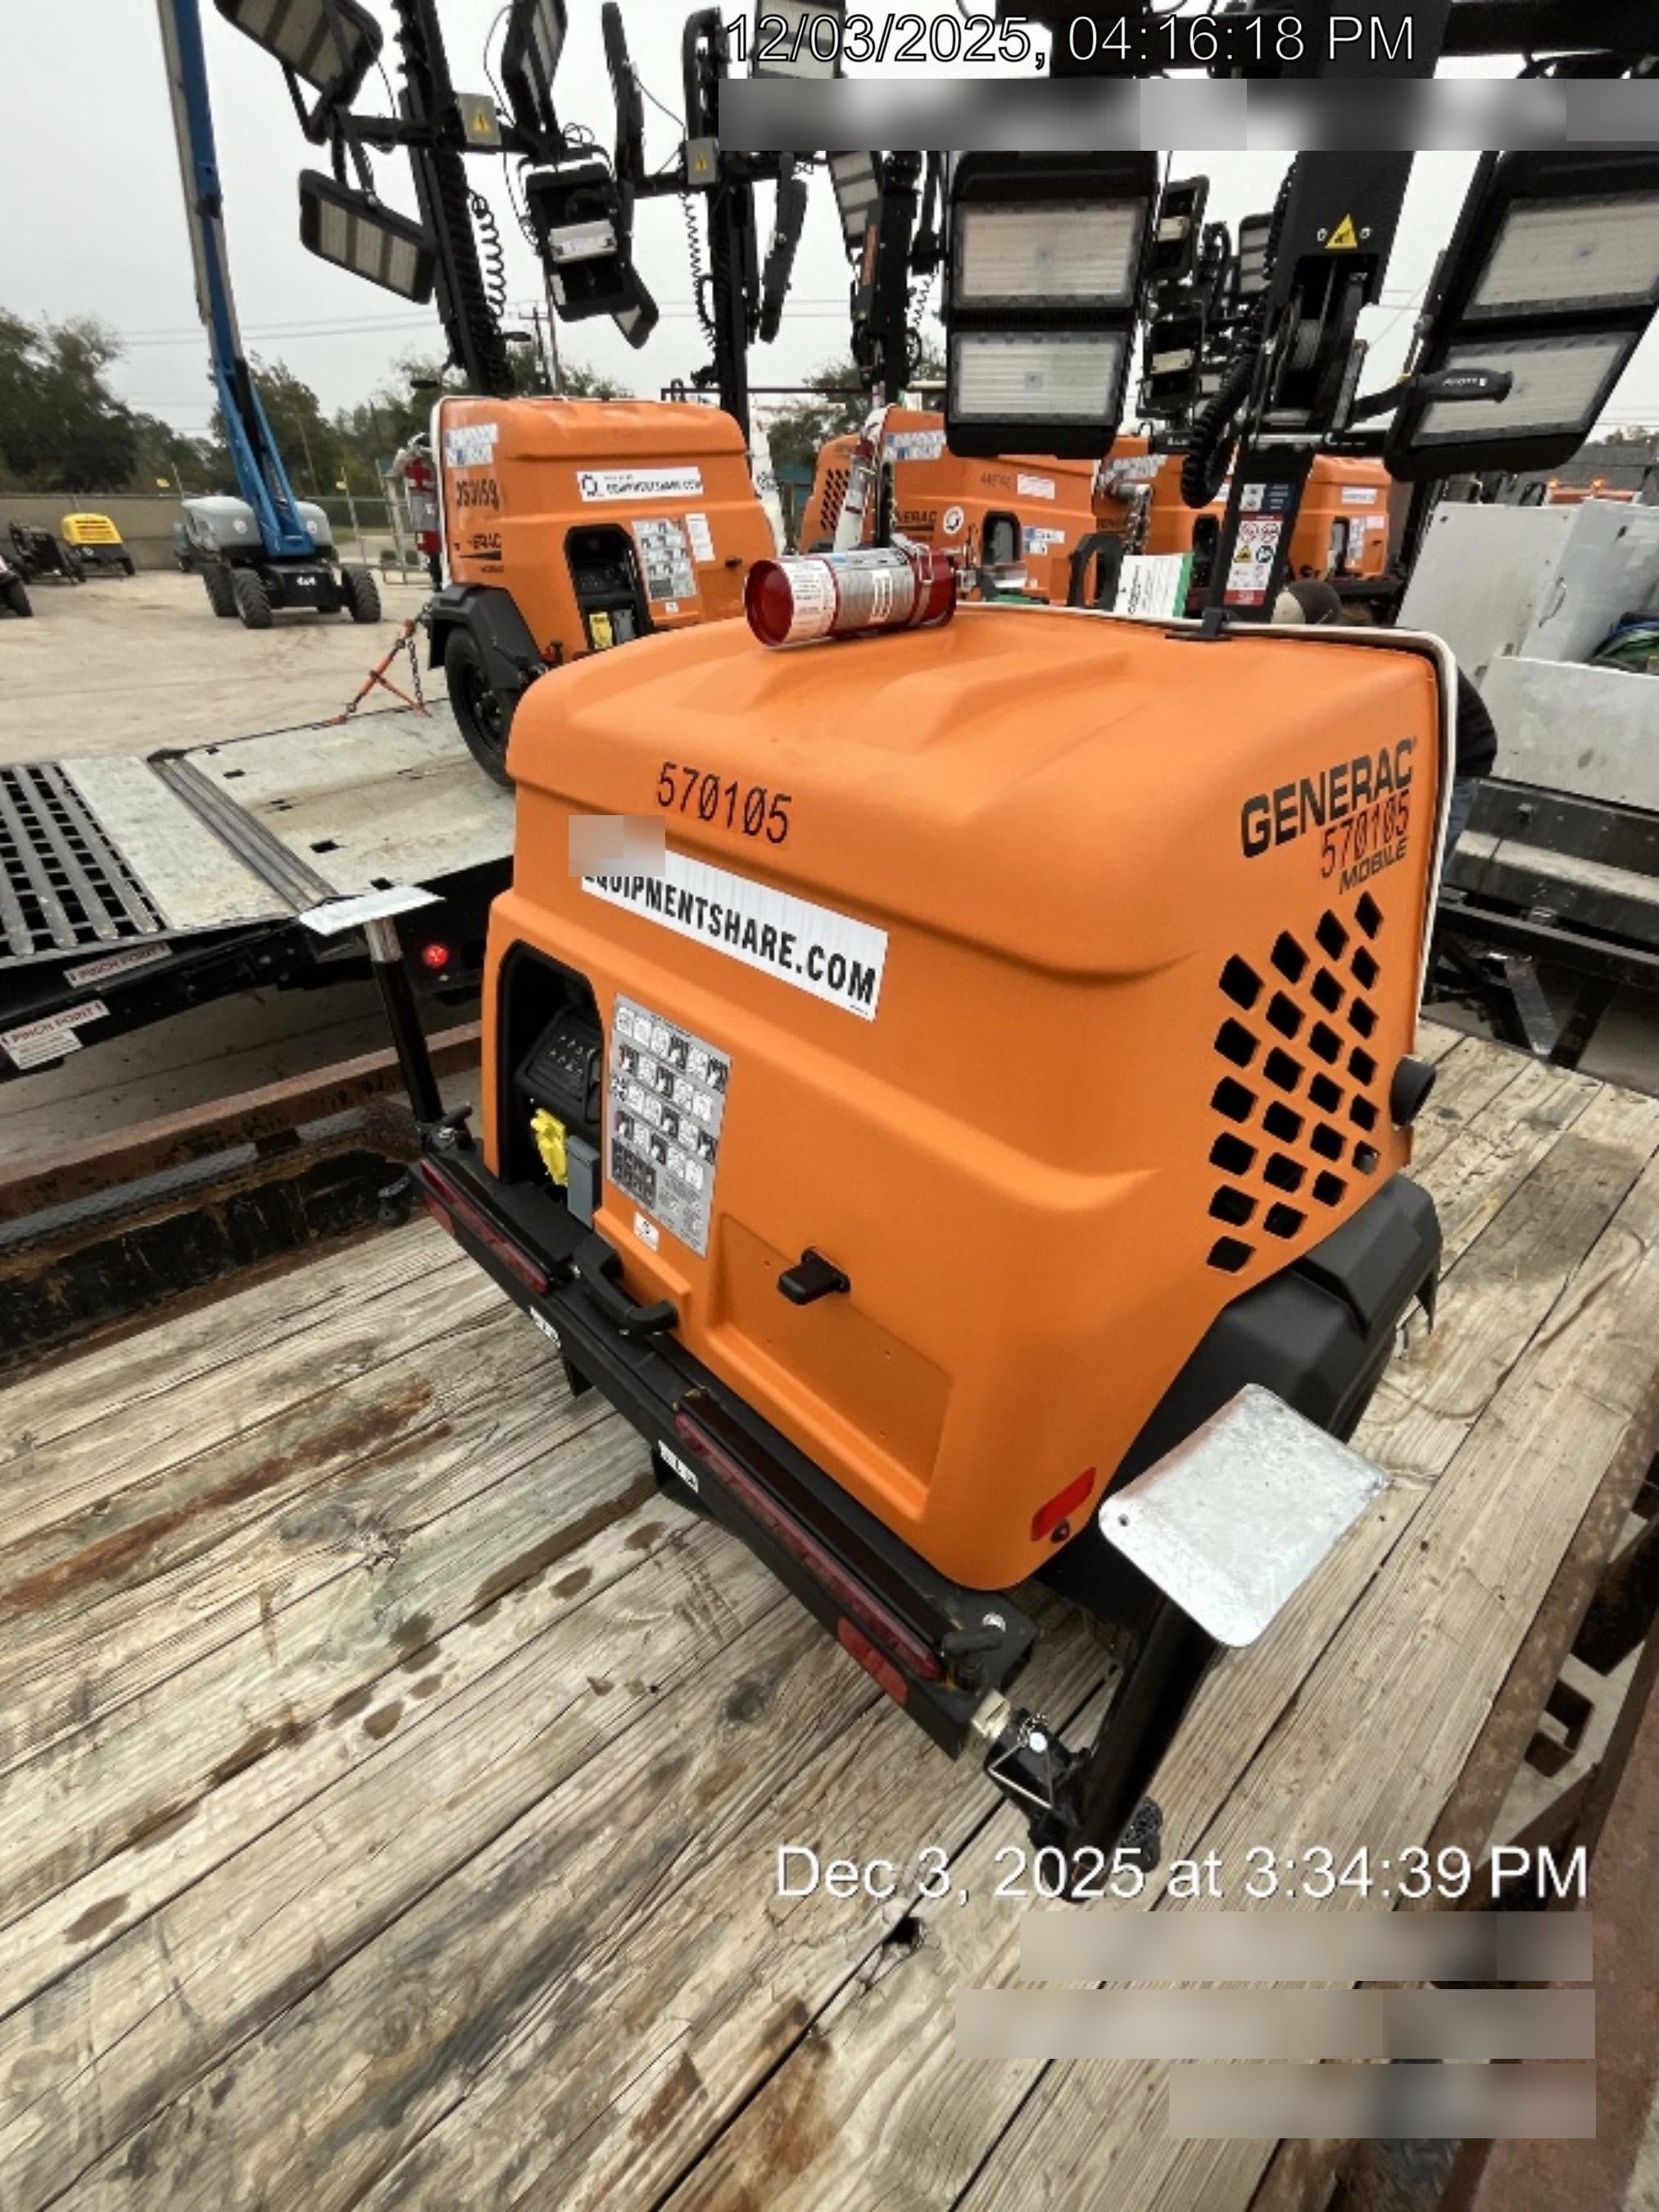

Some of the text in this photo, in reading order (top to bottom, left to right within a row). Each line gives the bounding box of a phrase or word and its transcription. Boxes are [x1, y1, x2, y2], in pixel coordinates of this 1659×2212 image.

[895, 510, 938, 524] ERAC
[657, 761, 792, 844] 570105
[1241, 738, 1412, 859] GENERAC
[1321, 788, 1410, 878] 570105
[1339, 836, 1407, 895] MOBILE
[584, 877, 877, 1005] QUIPMENTSHARE.COM
[11, 1007, 93, 1042] PINCH POINT
